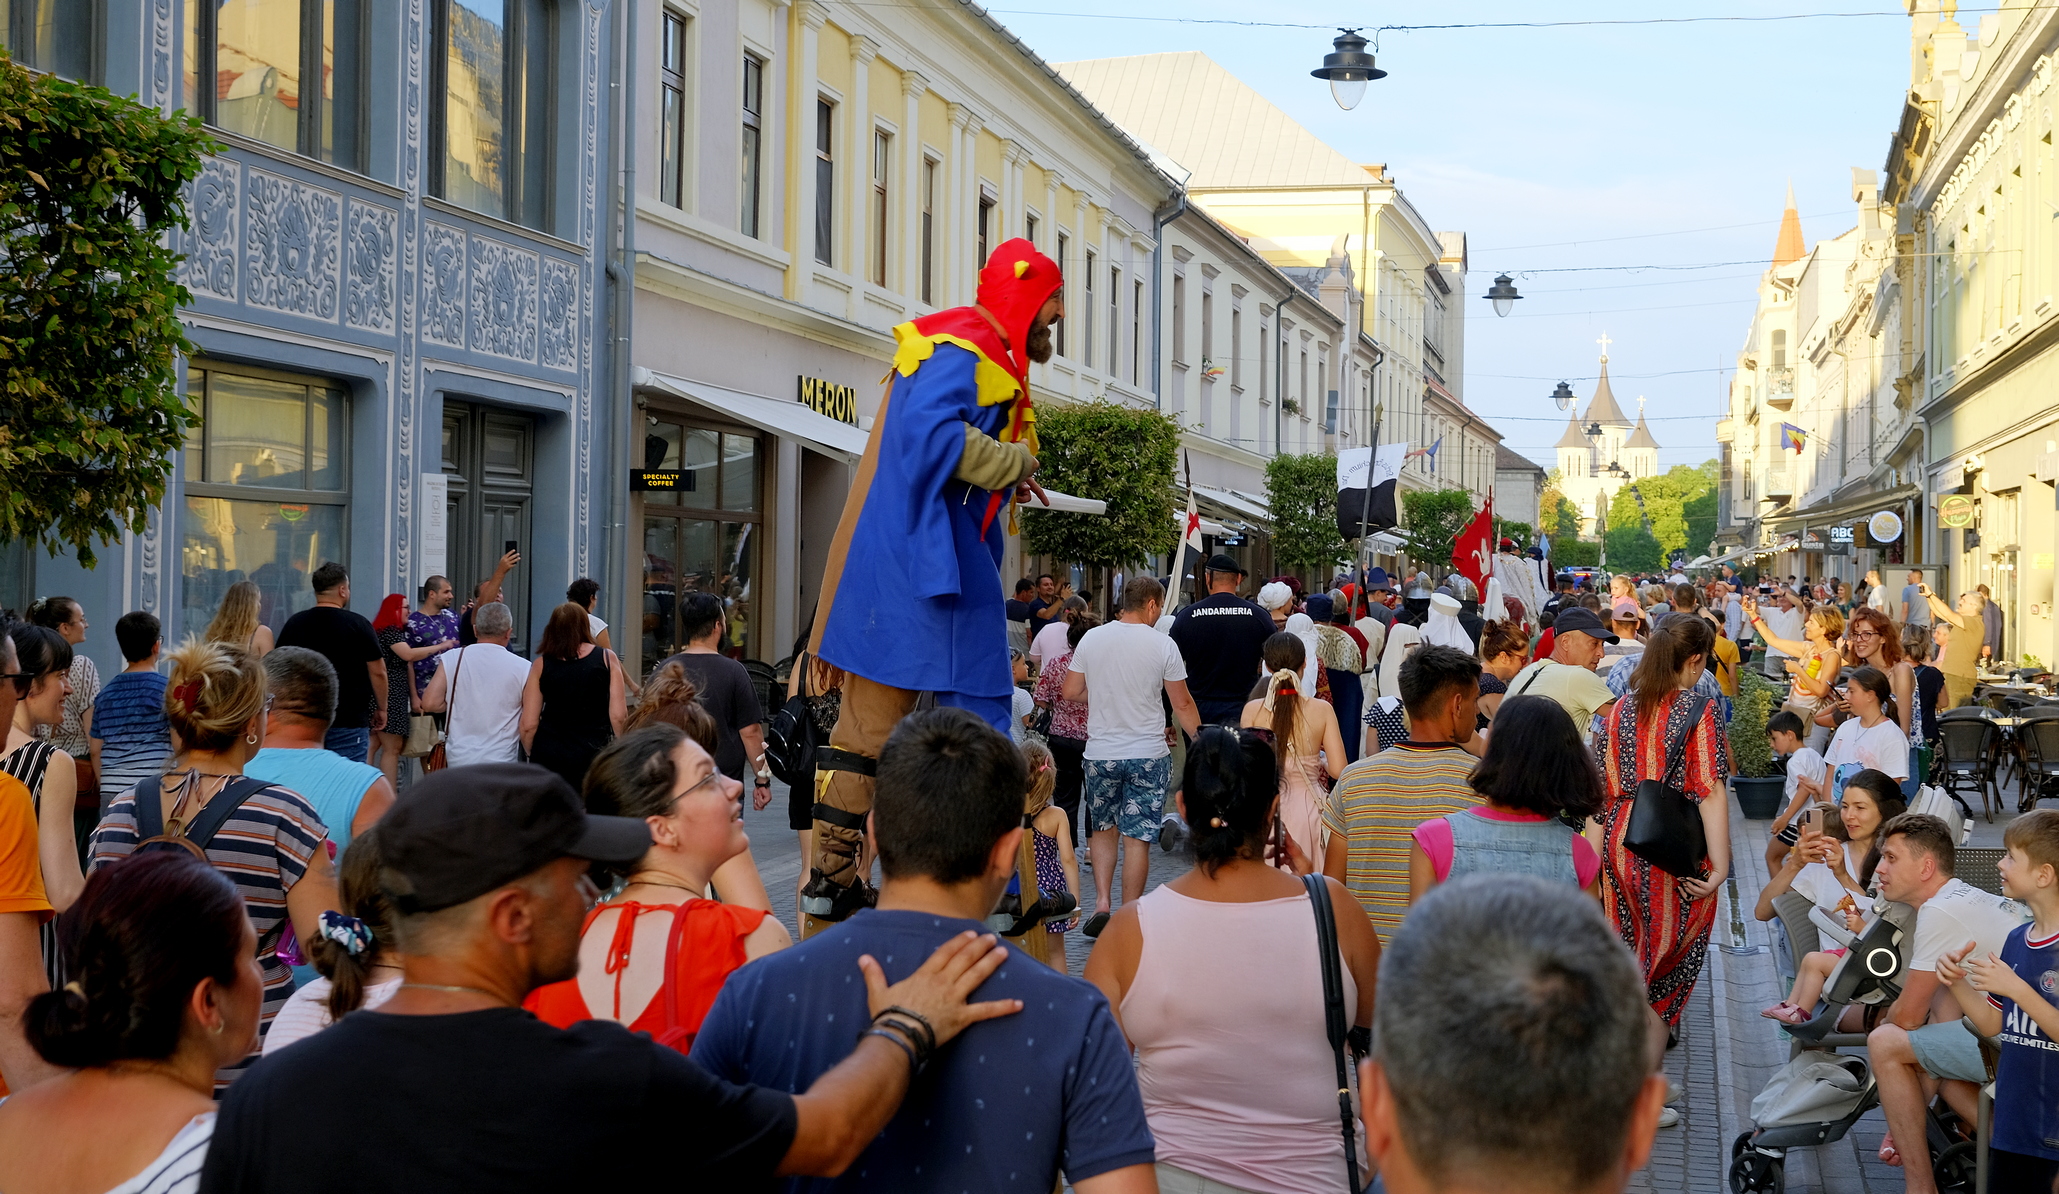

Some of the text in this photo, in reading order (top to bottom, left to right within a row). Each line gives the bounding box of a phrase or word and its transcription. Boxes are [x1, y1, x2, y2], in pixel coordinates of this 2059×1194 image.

[801, 374, 857, 424] MERON
[1831, 527, 1854, 538] ABC
[1191, 607, 1253, 618] JANDARMERIA
